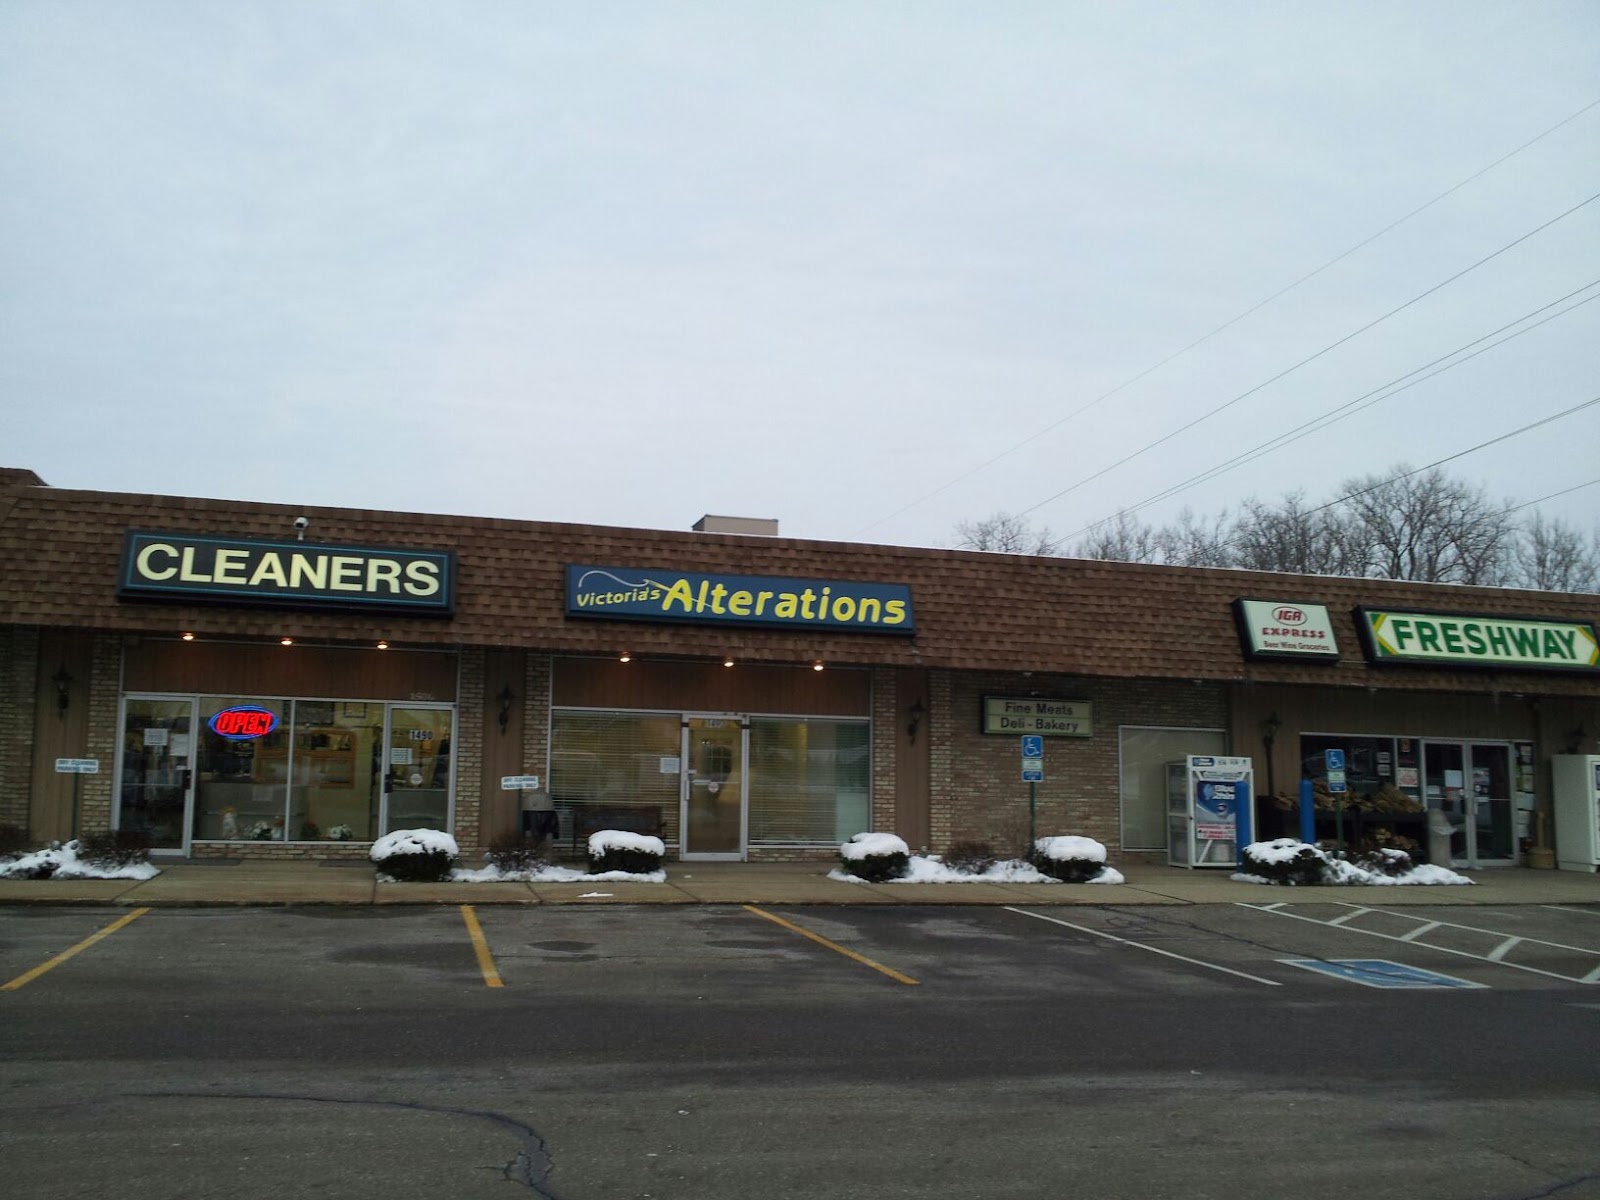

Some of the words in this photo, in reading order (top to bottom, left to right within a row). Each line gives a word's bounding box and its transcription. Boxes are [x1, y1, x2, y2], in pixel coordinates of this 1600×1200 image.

[136, 543, 439, 596] CLEANERS
[661, 578, 906, 624] Alterations
[1278, 610, 1302, 621] IGA
[1261, 627, 1326, 639] EXPRESS
[1391, 619, 1577, 660] FRESHWAY
[1004, 701, 1032, 714] Fine
[1036, 703, 1074, 716] Meats
[215, 711, 273, 735] OPEN
[1000, 717, 1025, 729] Deli
[1035, 718, 1079, 733] Bakery
